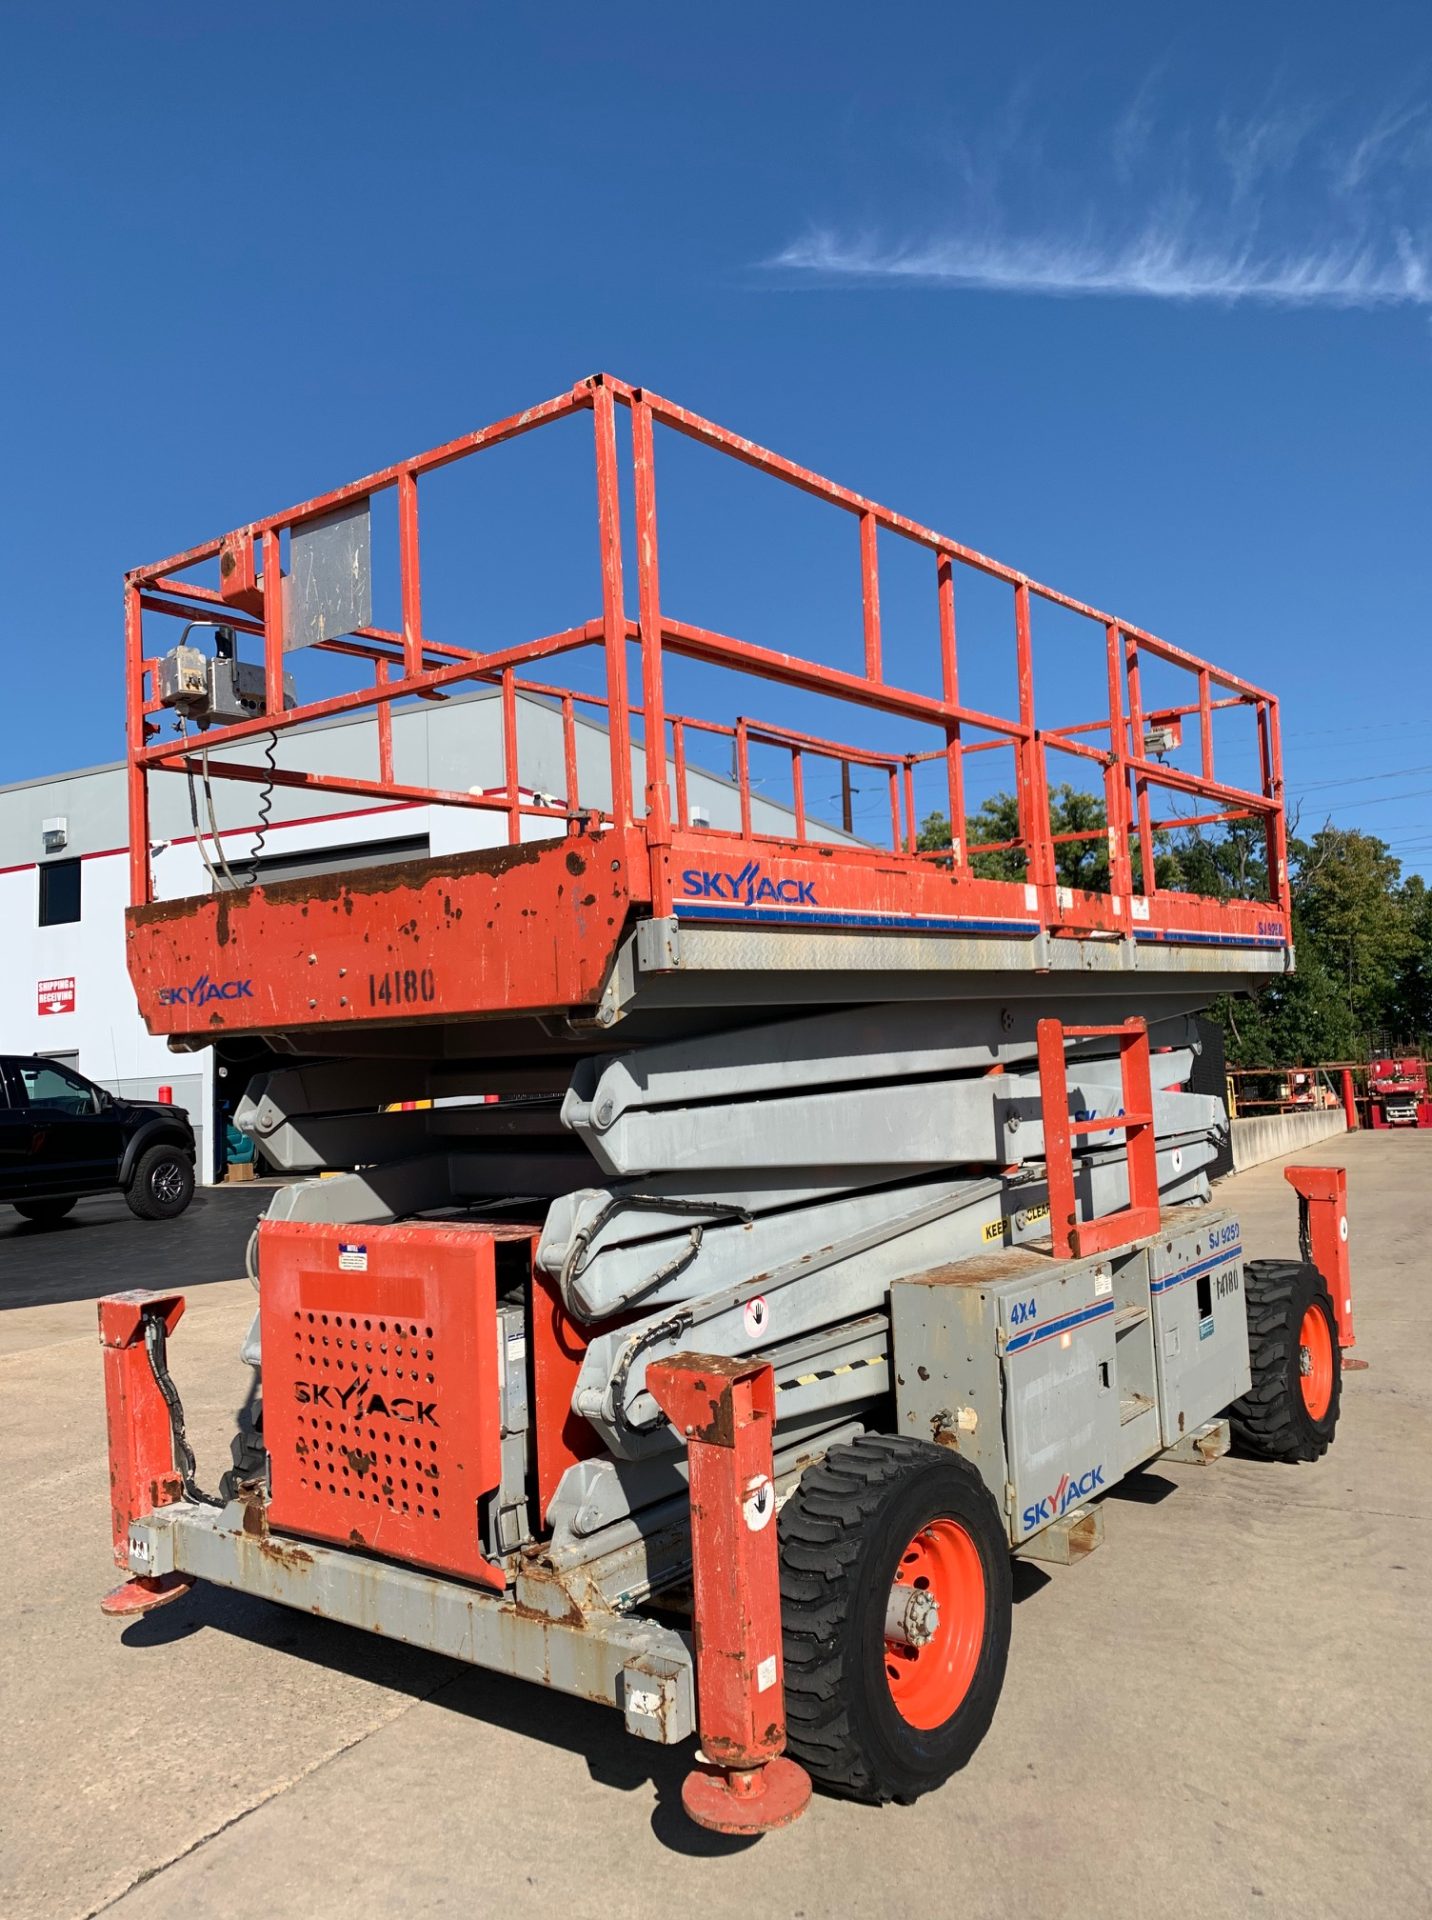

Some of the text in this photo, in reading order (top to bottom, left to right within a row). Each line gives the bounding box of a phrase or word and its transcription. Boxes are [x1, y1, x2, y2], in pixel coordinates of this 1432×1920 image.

[682, 860, 819, 906] SKYJACK
[38, 980, 69, 993] SHIPPING
[39, 991, 73, 1003] RECEIVING
[158, 975, 254, 1007] SKYJACK
[369, 969, 435, 1007] 14180
[985, 1220, 1008, 1240] KEEP
[1209, 1222, 1240, 1250] SJ 9250
[1010, 1297, 1037, 1326] 4X4
[294, 1376, 441, 1428] SKYJACK
[1023, 1464, 1105, 1531] SKYJACK
